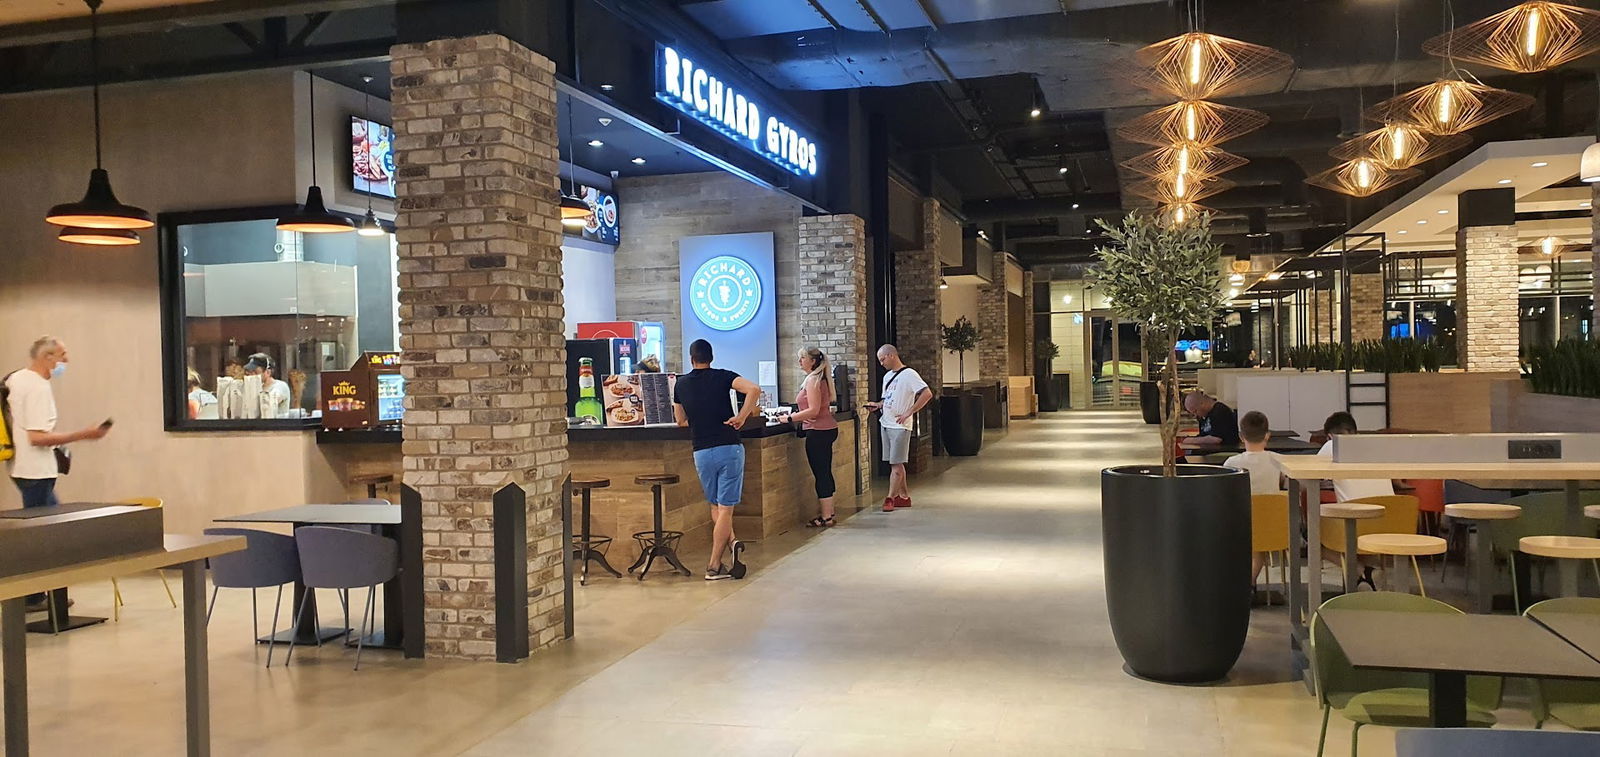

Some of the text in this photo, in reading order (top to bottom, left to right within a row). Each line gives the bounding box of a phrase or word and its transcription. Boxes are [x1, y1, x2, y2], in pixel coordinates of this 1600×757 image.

[665, 47, 817, 175] RICHARD GYROS
[698, 262, 751, 287] RICHARD
[332, 385, 357, 395] KING
